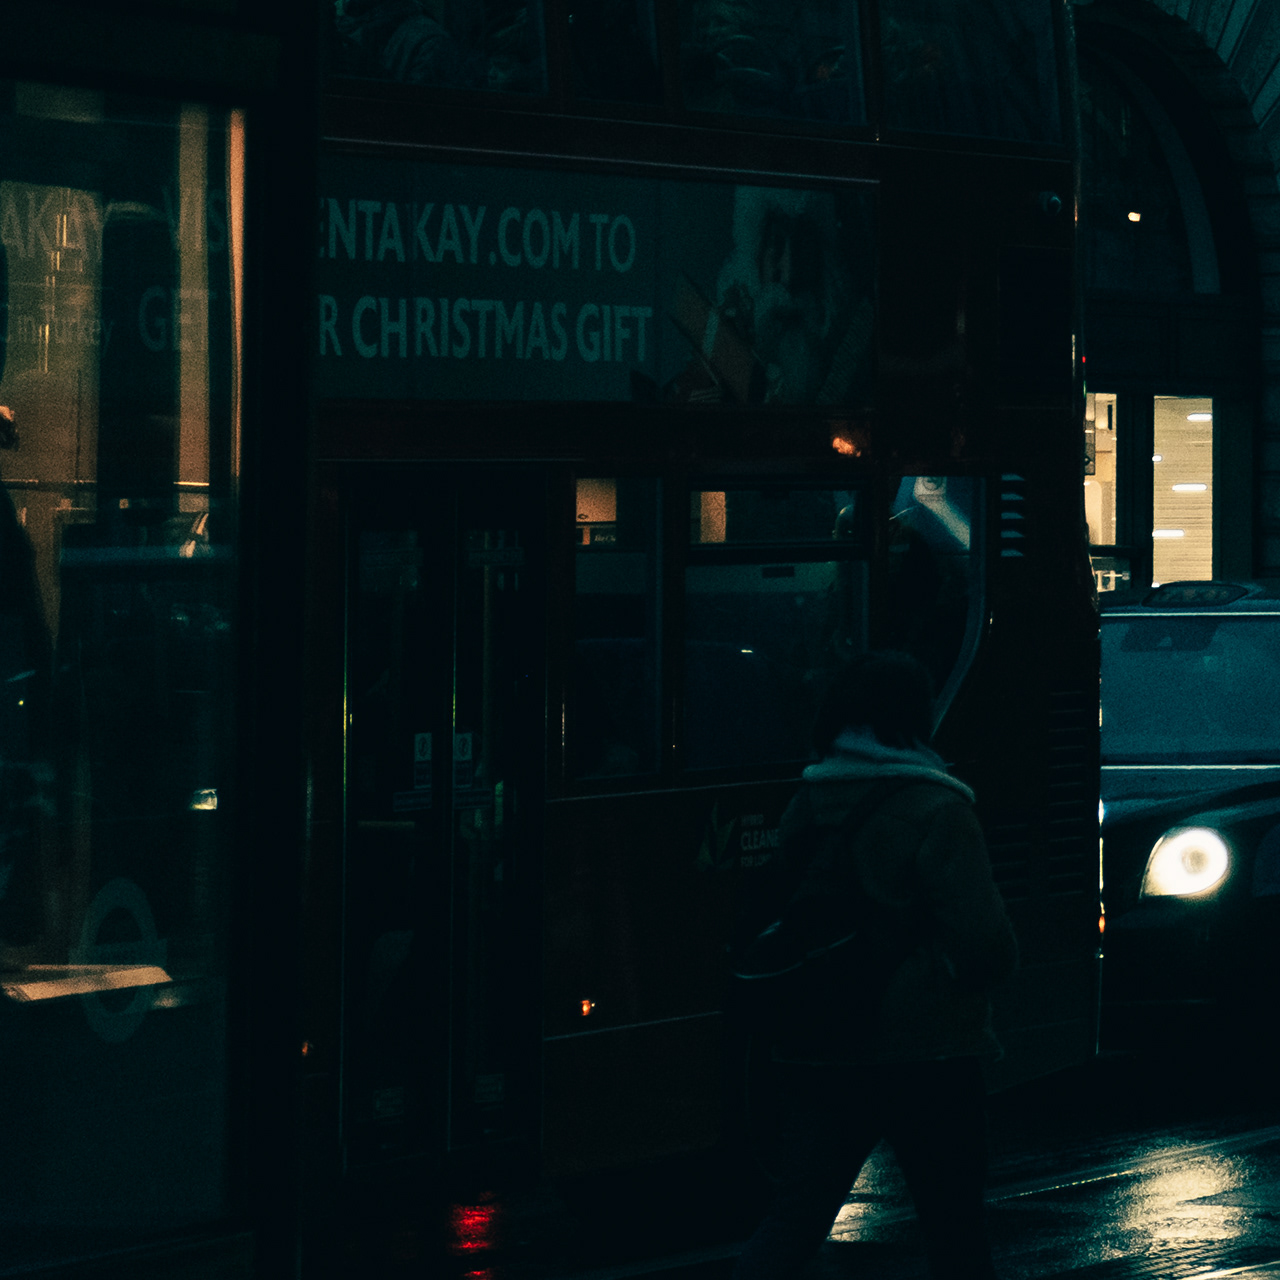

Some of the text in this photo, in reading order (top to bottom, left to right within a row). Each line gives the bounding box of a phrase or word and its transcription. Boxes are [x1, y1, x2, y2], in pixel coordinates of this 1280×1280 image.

[318, 197, 580, 271] NTAKAY.COM
[589, 213, 637, 274] TO
[351, 294, 568, 361] CHRISTMAS
[576, 302, 654, 363] GIFT
